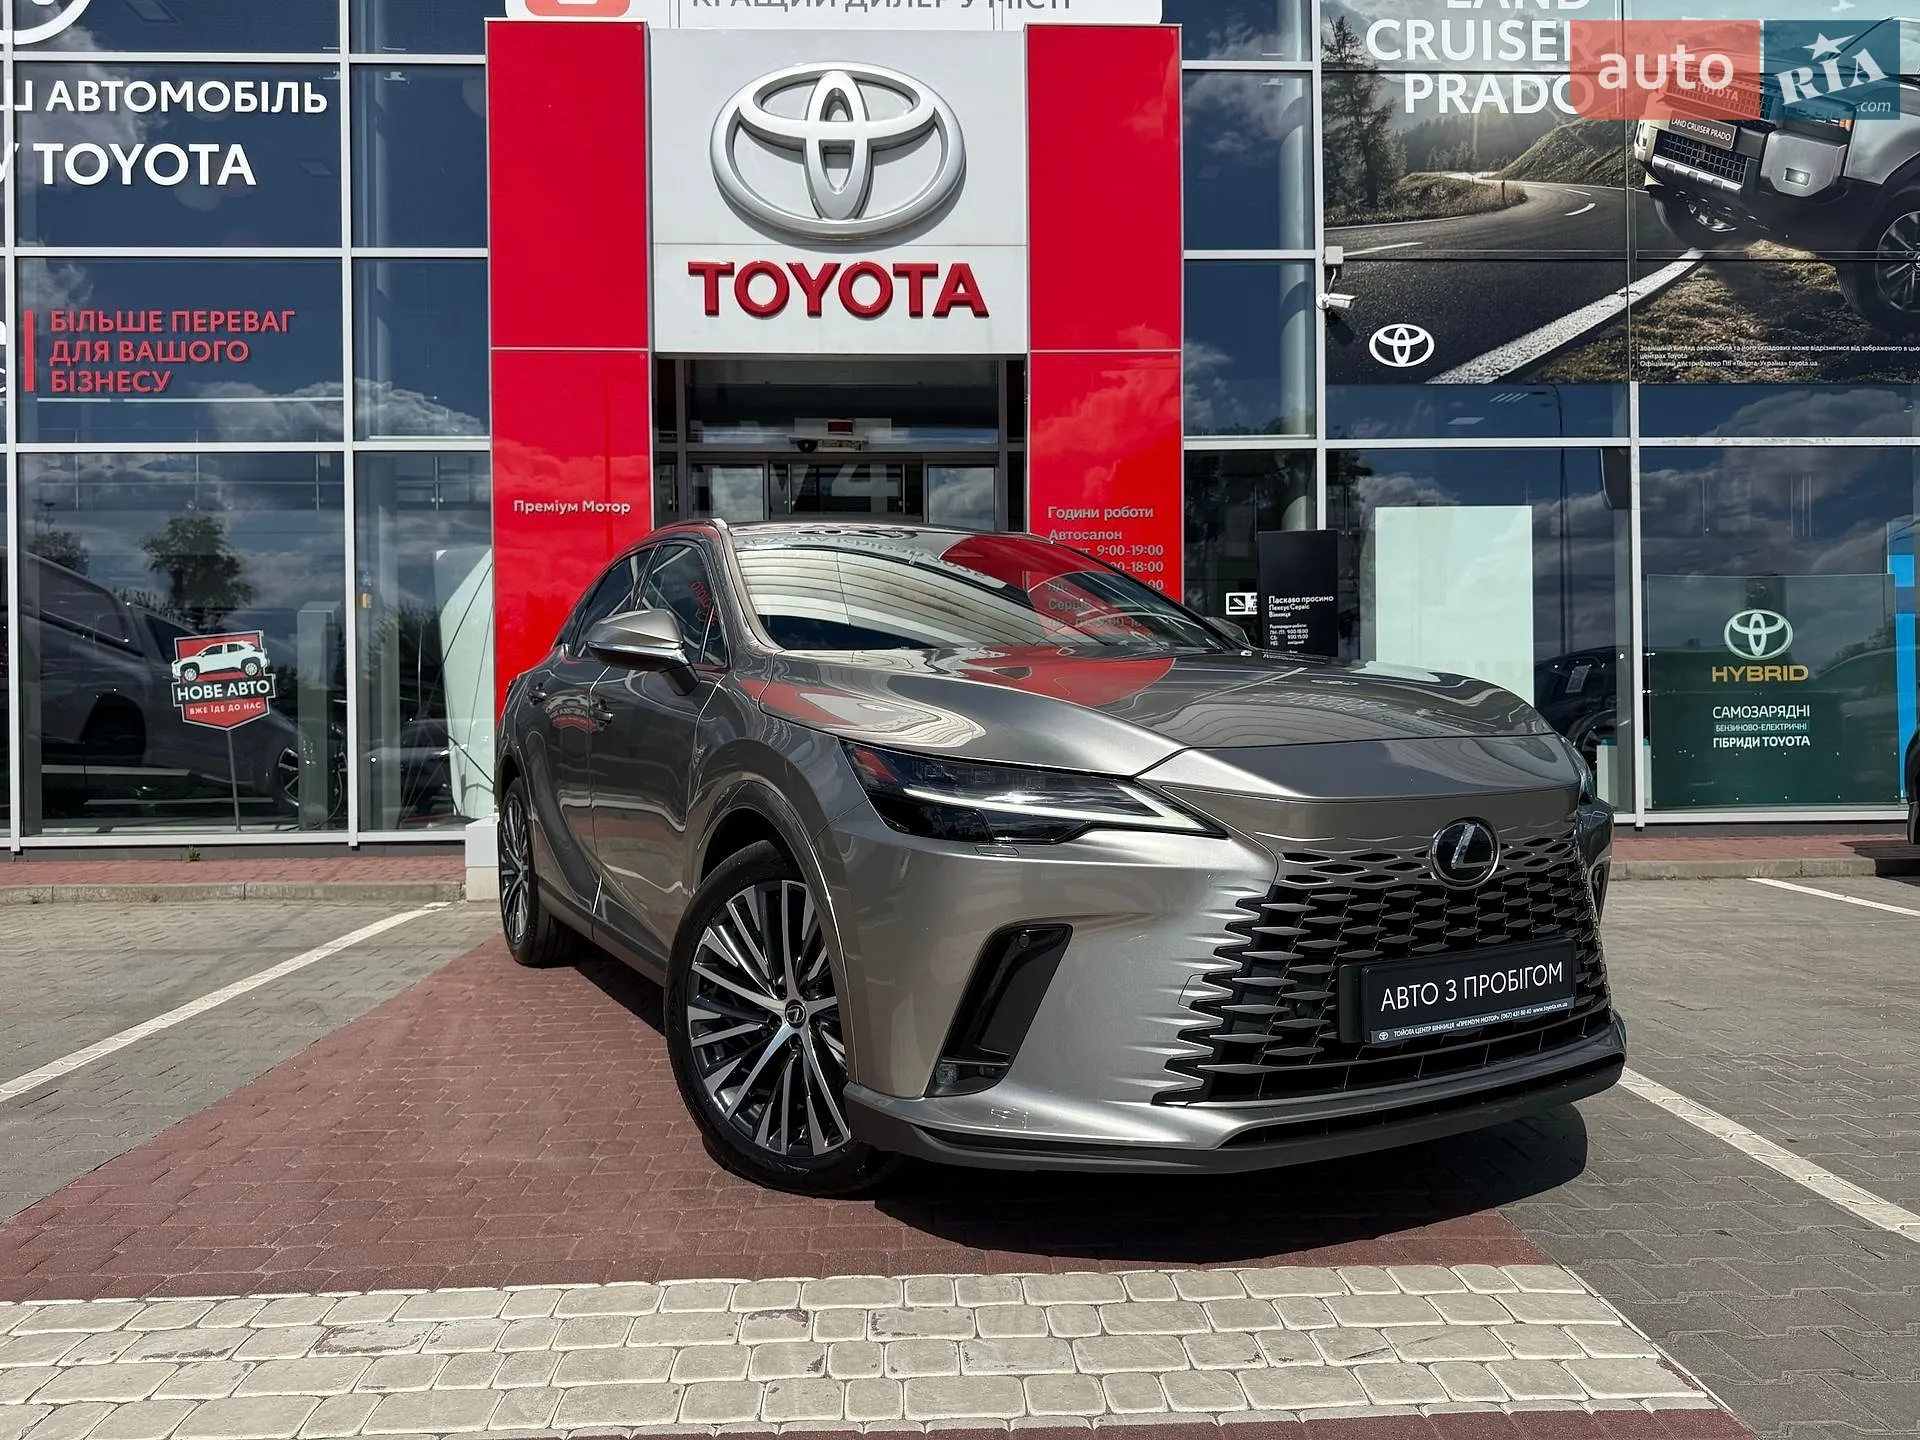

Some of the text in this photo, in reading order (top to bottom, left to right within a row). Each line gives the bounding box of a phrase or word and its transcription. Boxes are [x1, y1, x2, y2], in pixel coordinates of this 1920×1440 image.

[1366, 19, 1596, 61] CRUISER
[45, 80, 328, 113] АВТОМОБІЛЬ
[1404, 73, 1595, 115] PRADO
[1687, 120, 1710, 136] CRUISER
[1710, 126, 1732, 142] PRADO
[33, 143, 257, 186] TOYOTA
[688, 260, 989, 318] TOYOTA
[50, 310, 295, 333] БІЛЬШЕ ПЕРЕВАГ
[49, 340, 249, 366] ДЛЯ ВАШОГО
[50, 370, 171, 393] БІЗНЕСУ
[514, 500, 630, 514] Преміум Мотор
[1048, 506, 1153, 521] Години роботи
[1049, 529, 1123, 540] Автосалон
[1097, 544, 1164, 556] 9:00-19:00
[1711, 665, 1809, 683] HYBRID
[177, 680, 270, 701] НОВЕ АВТО
[228, 704, 241, 712] ДО
[243, 702, 261, 711] НАС
[1712, 705, 1810, 719] САМОЗАРЯДНІ
[1715, 723, 1807, 732] БЕНЗИНОВО-ЕЛЕКТРИЧНІ
[1713, 735, 1811, 749] ГІБРИДИ TOYOTA
[1380, 961, 1563, 1012] АВТО З ПРОБІГОМ
